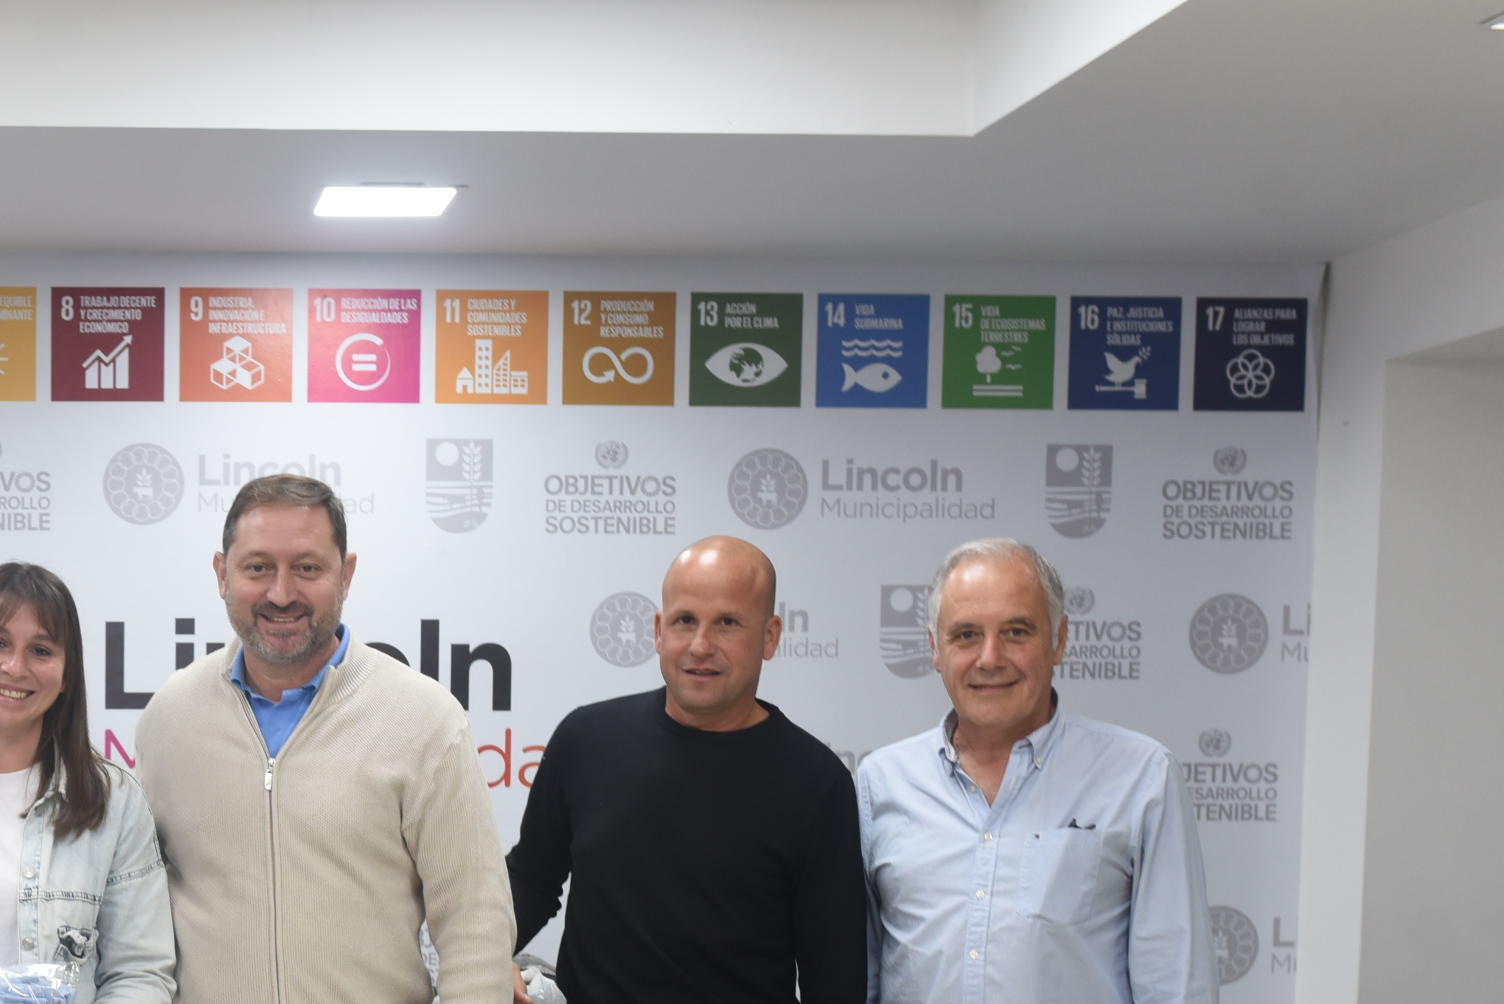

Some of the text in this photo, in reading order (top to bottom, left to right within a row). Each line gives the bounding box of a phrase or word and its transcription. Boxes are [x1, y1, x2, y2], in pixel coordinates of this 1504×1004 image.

[61, 296, 74, 320] 8
[80, 296, 156, 307] TRABAJO DECENTE
[190, 296, 203, 321] 9
[314, 297, 335, 322] 10
[390, 298, 400, 309] DE
[402, 298, 418, 310] LAS
[855, 304, 875, 315] VIDA
[980, 305, 1000, 316] VIDA
[80, 309, 142, 320] Y CRECIMIENTO
[341, 312, 408, 323] DESIGUALDADES
[443, 299, 460, 323] 11
[467, 312, 527, 323] COMUNIDADES
[571, 300, 591, 325] 12
[600, 313, 649, 325] Y CONSUMO
[697, 301, 718, 326] 13
[825, 302, 845, 327] 14
[953, 304, 973, 328] 15
[1078, 305, 1099, 330] 16
[1206, 306, 1225, 331] 17
[80, 321, 128, 333] ECONÓMICO
[208, 322, 287, 333] INFRAESTRUCTURA
[467, 325, 522, 336] SOSTENIBLES
[724, 316, 742, 328] POR
[753, 317, 779, 328] CLIMA
[980, 318, 990, 329] DE
[600, 326, 664, 338] RESPONSABLES
[821, 459, 963, 492] Lincoln
[544, 475, 676, 496] OBJETIVOS
[1162, 480, 1294, 501] OBJETIVOS
[546, 499, 676, 513] DE DESARROLLO
[820, 498, 996, 523] Municipalidad
[1163, 505, 1293, 519] DE DESARROLLO
[545, 516, 676, 535] SOSTENIBLE
[1162, 521, 1293, 540] SOSTENIBLE
[1071, 620, 1142, 642] TIVOS
[1066, 645, 1141, 659] ARROLLO
[1059, 661, 1141, 680] TENIBLE
[1183, 762, 1278, 783] JETIVOS
[1188, 787, 1277, 801] SARROLLO
[1193, 803, 1277, 821] TENIBLE
